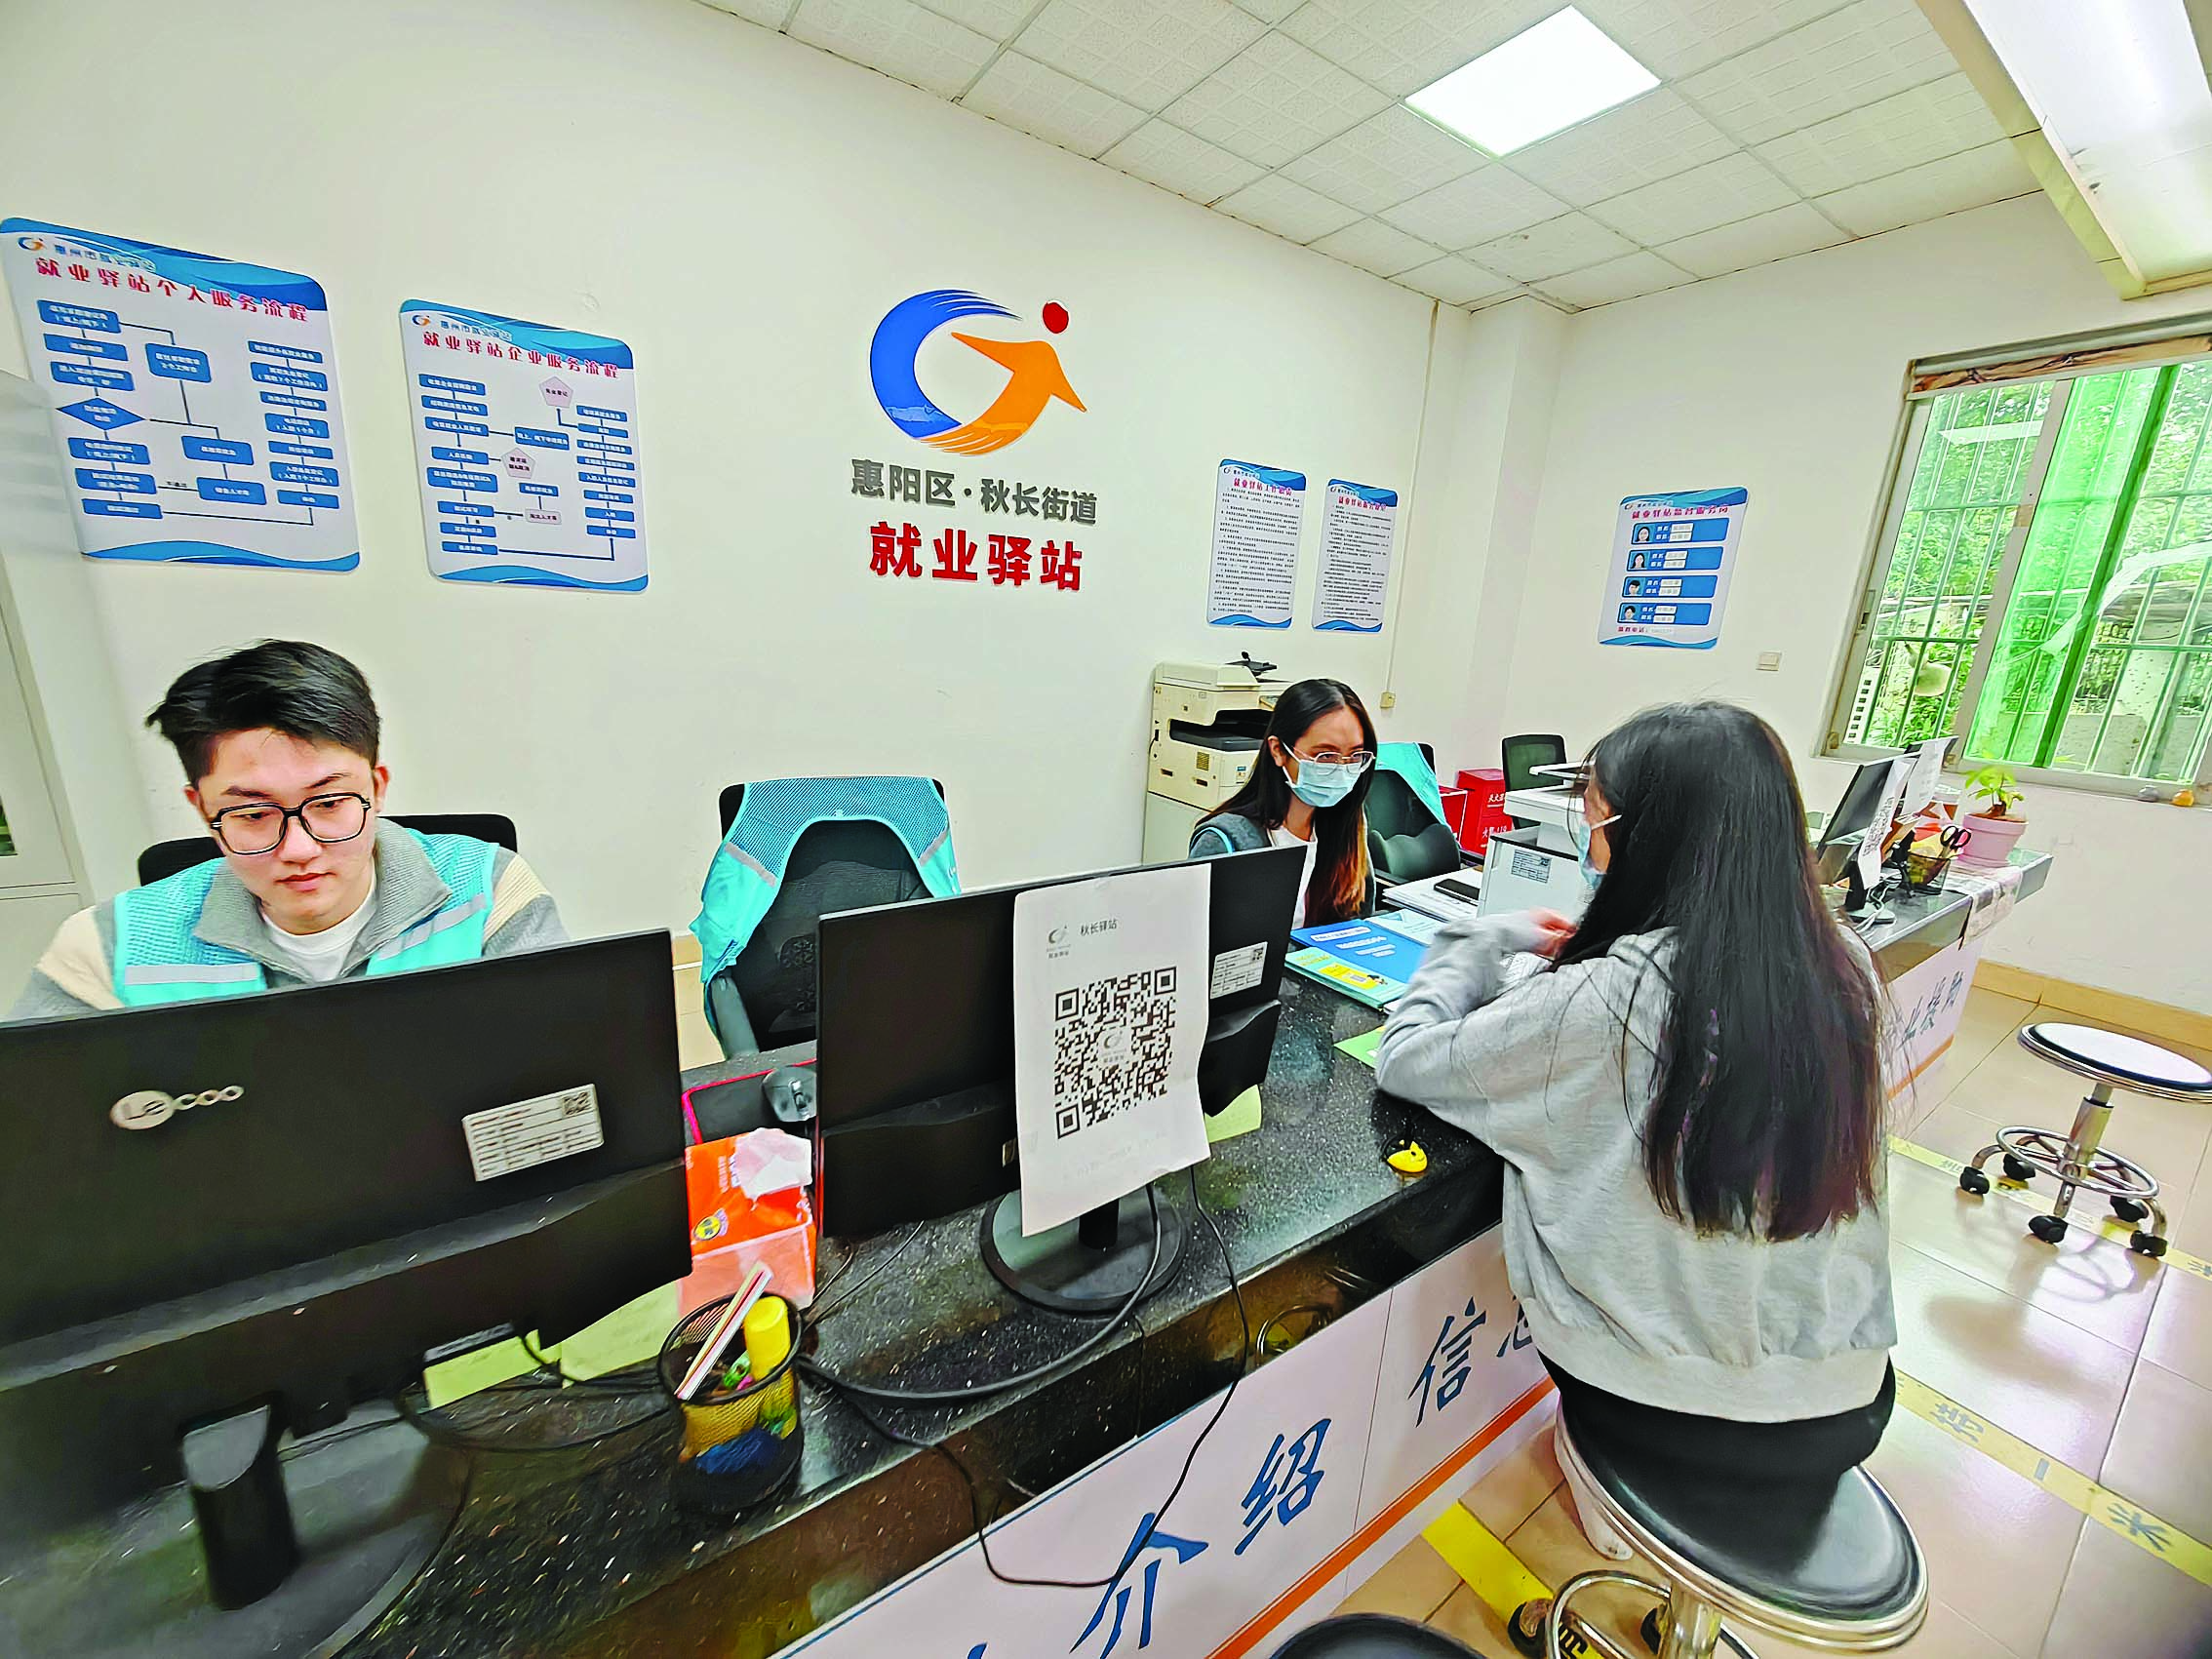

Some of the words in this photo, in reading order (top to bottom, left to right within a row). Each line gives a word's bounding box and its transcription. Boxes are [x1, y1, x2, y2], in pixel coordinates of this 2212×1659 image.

[35, 257, 308, 322] 就业驿站个人服务流程
[423, 331, 619, 378] 就业驿站企业服务流程
[850, 458, 1097, 525] 惠阳区·秋长街道
[869, 521, 1083, 591] 就业驿站
[1896, 1376, 2174, 1552] 持一米
[968, 1417, 1332, 1659] 介绍
